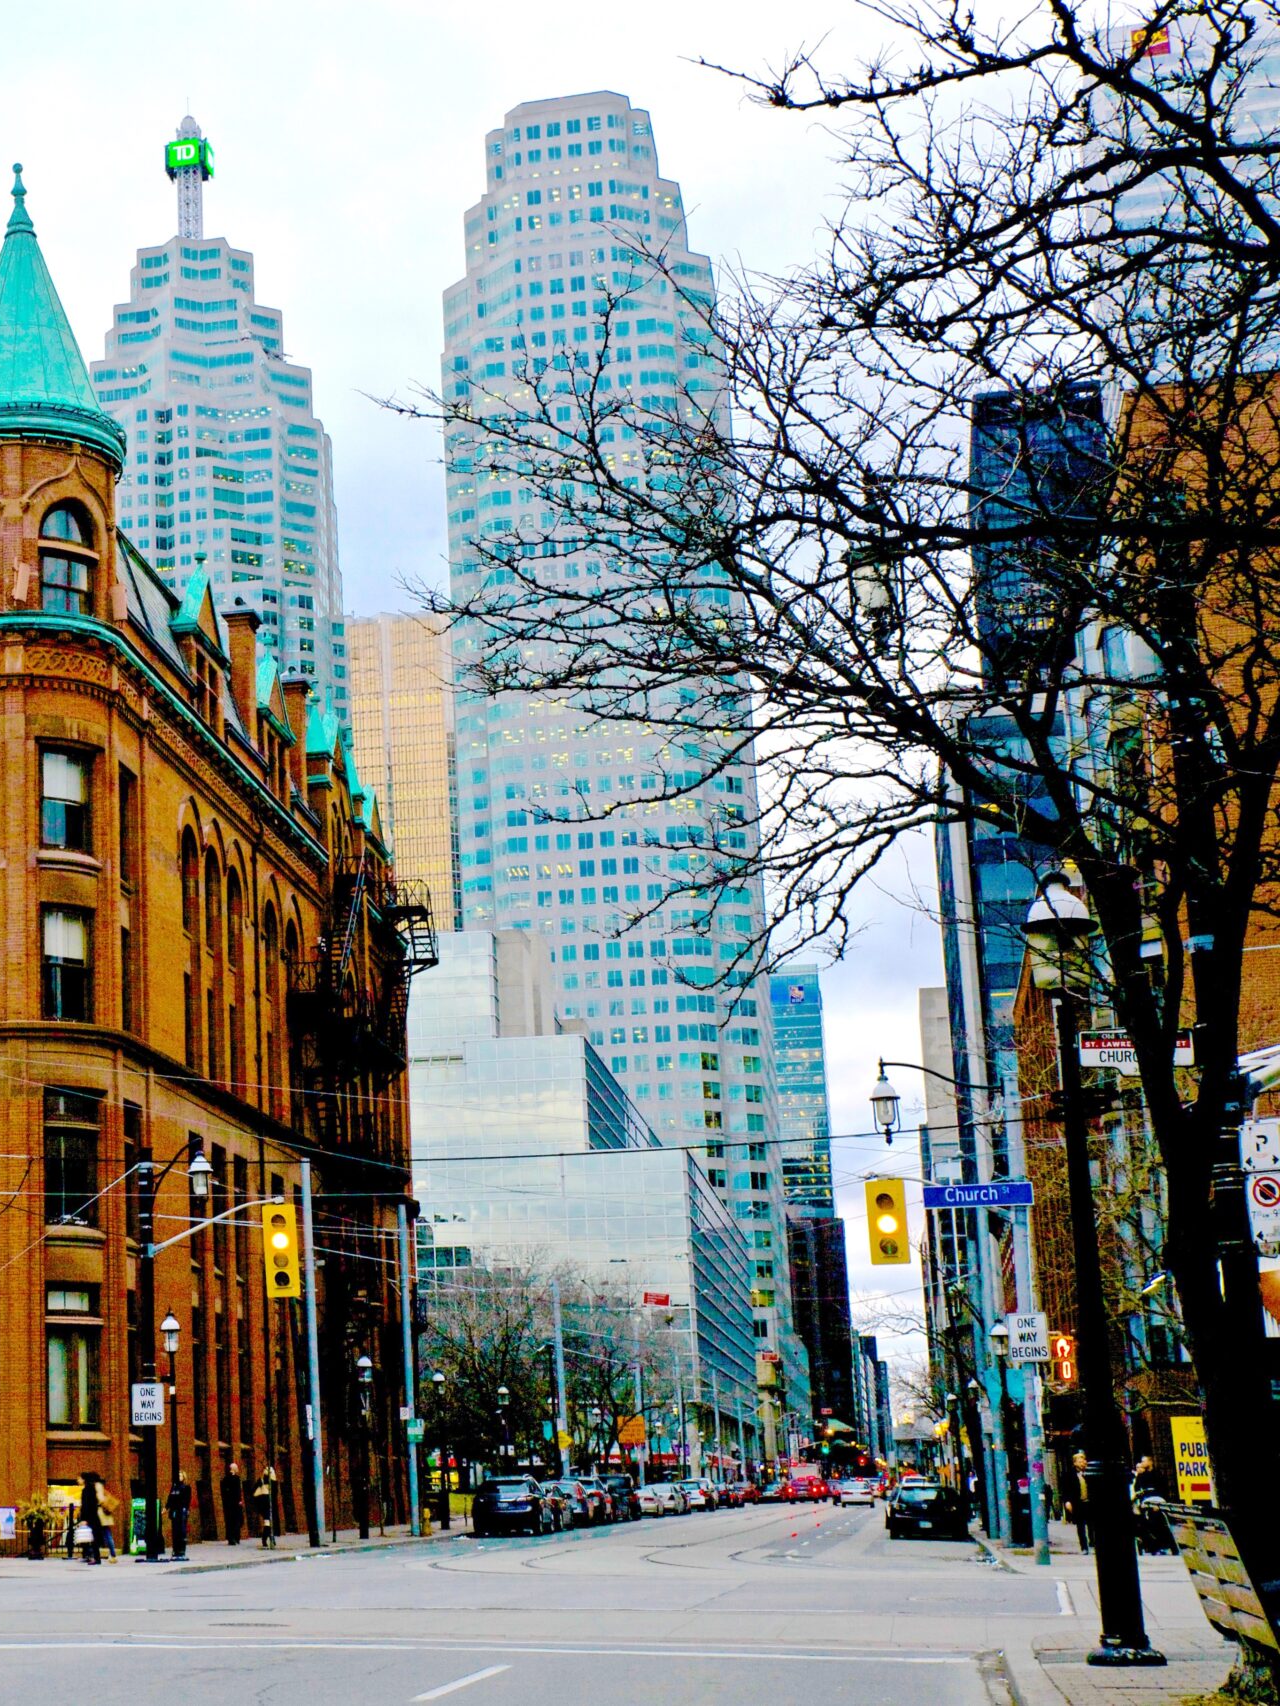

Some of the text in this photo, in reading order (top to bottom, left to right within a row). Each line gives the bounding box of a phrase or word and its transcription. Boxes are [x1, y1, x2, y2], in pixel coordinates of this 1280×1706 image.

[172, 144, 196, 161] TD
[1099, 1050, 1139, 1063] CHURC
[945, 1187, 999, 1202] Church
[1017, 1317, 1037, 1329] ONE
[1018, 1332, 1038, 1343] WAY
[1011, 1346, 1048, 1358] BEGINS
[140, 1387, 156, 1397] ONE
[140, 1400, 156, 1409] WAY
[134, 1412, 162, 1422] BEGINS
[1178, 1462, 1209, 1477] PARK
